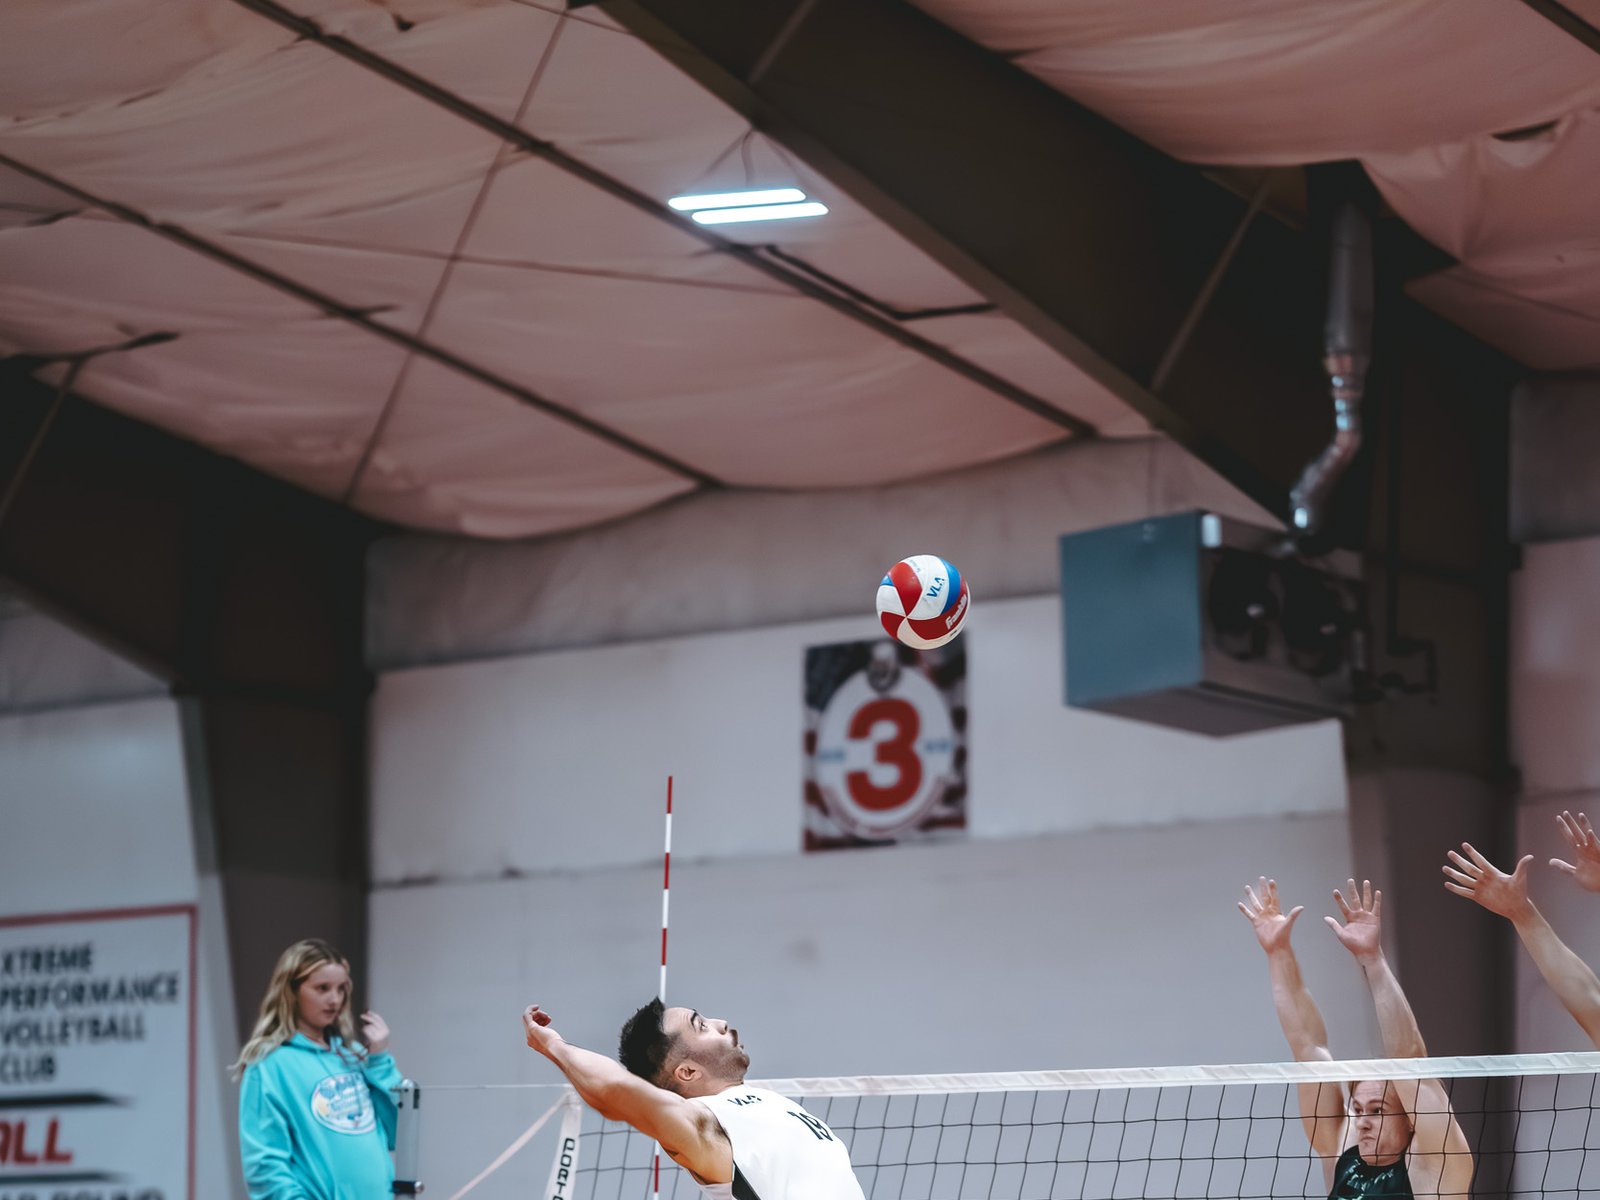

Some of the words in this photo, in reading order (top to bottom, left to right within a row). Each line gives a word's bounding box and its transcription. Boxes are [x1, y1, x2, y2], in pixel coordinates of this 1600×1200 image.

[926, 577, 945, 598] VLA
[845, 698, 923, 812] 3
[0, 1013, 145, 1048] VOLLEYBALL
[0, 1053, 55, 1083] CLUB
